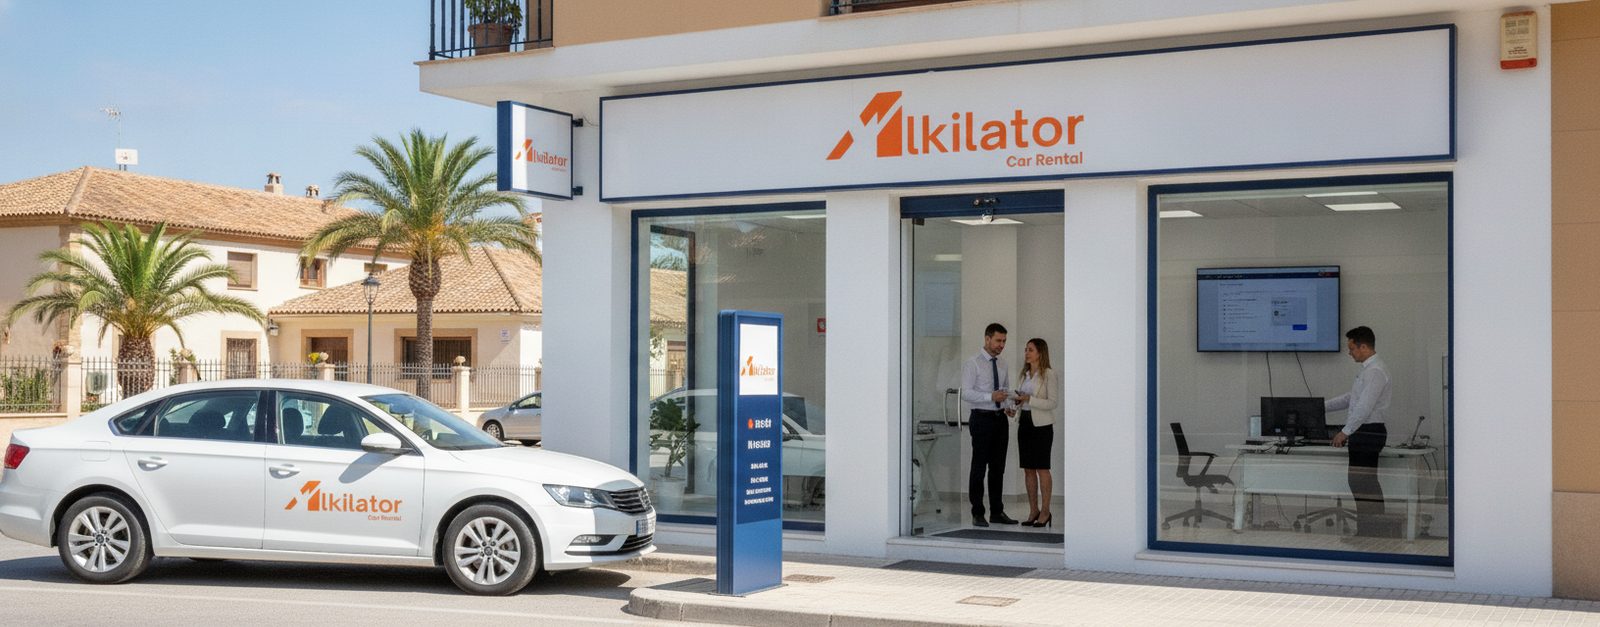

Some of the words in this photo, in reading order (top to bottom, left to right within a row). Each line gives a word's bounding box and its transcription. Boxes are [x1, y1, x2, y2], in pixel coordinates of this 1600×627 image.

[826, 91, 1084, 160] Alkilator
[1006, 155, 1032, 168] Car
[1035, 151, 1083, 166] Rental
[284, 480, 402, 513] Alkilator
